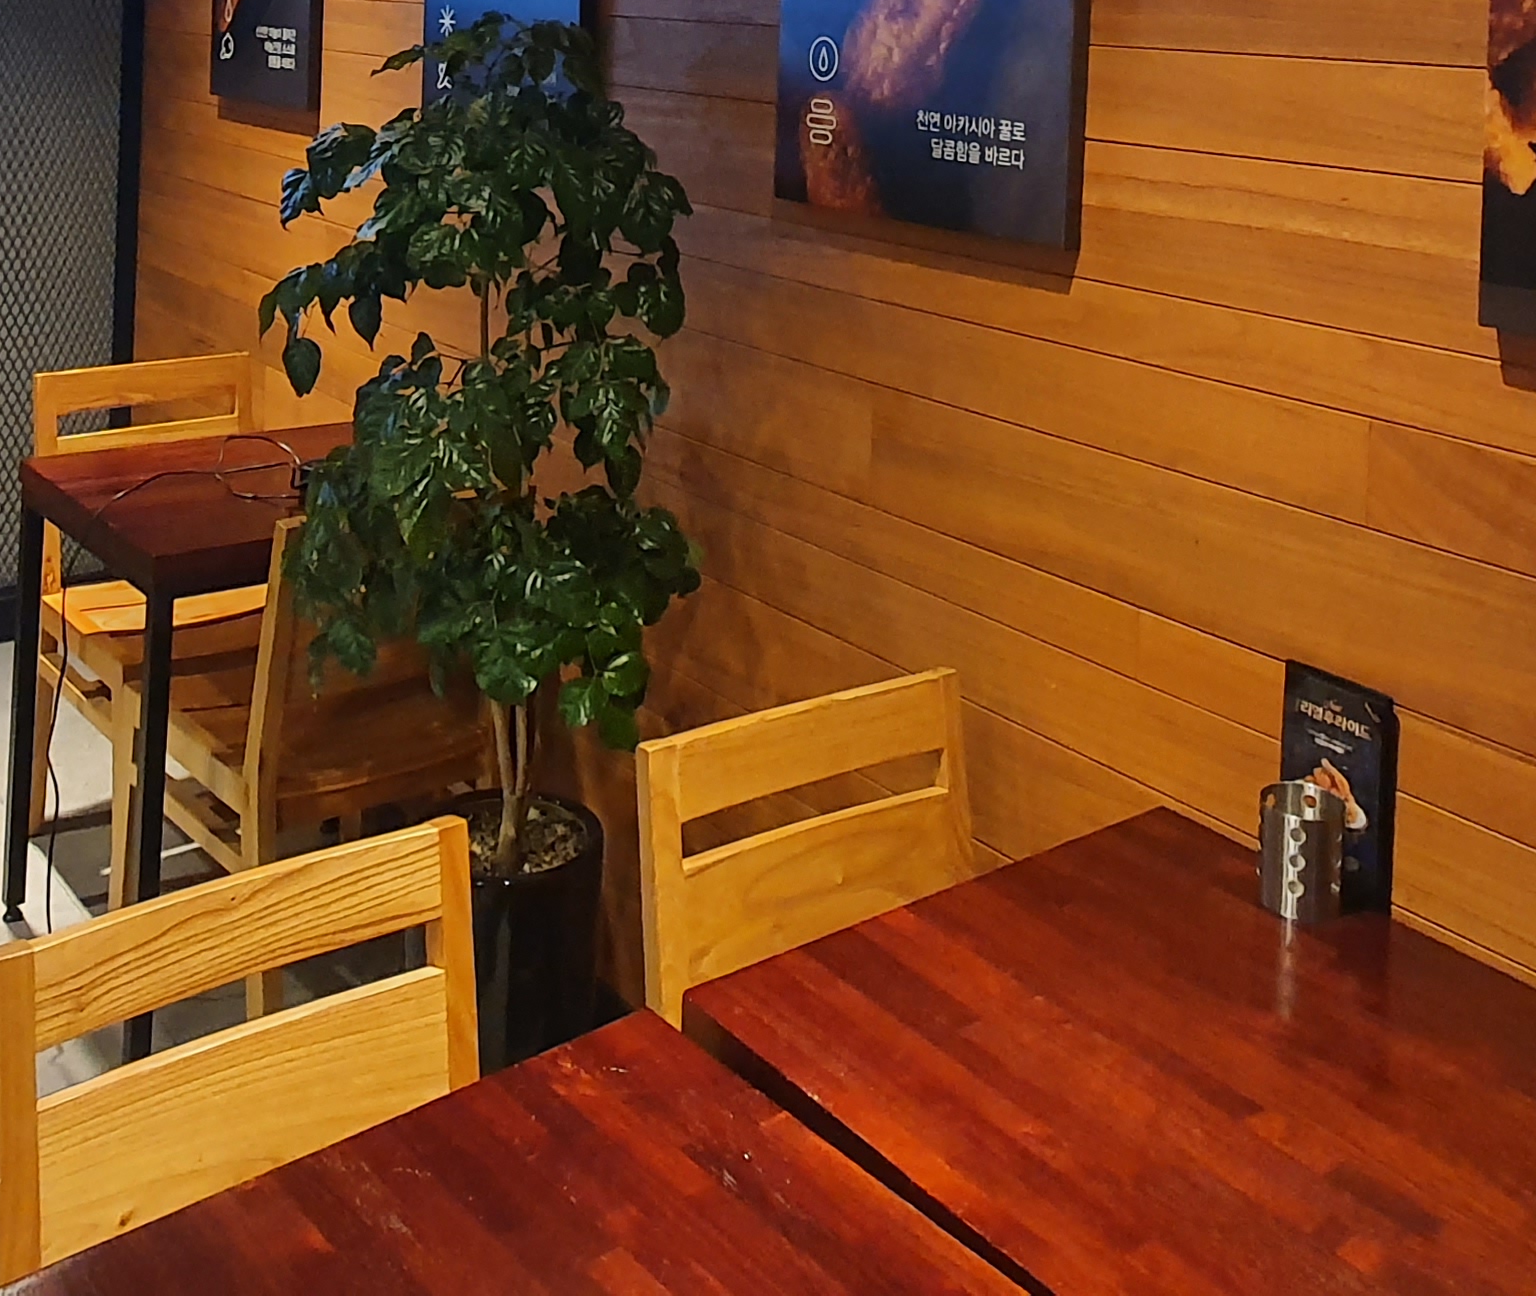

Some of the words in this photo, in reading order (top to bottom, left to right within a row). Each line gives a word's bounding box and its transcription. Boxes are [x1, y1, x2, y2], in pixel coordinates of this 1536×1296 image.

[916, 109, 941, 132] 천연
[944, 113, 996, 139] 아카시아
[998, 119, 1026, 142] 꿀로
[931, 138, 981, 165] 달콤함을
[985, 146, 1025, 171] 바르다
